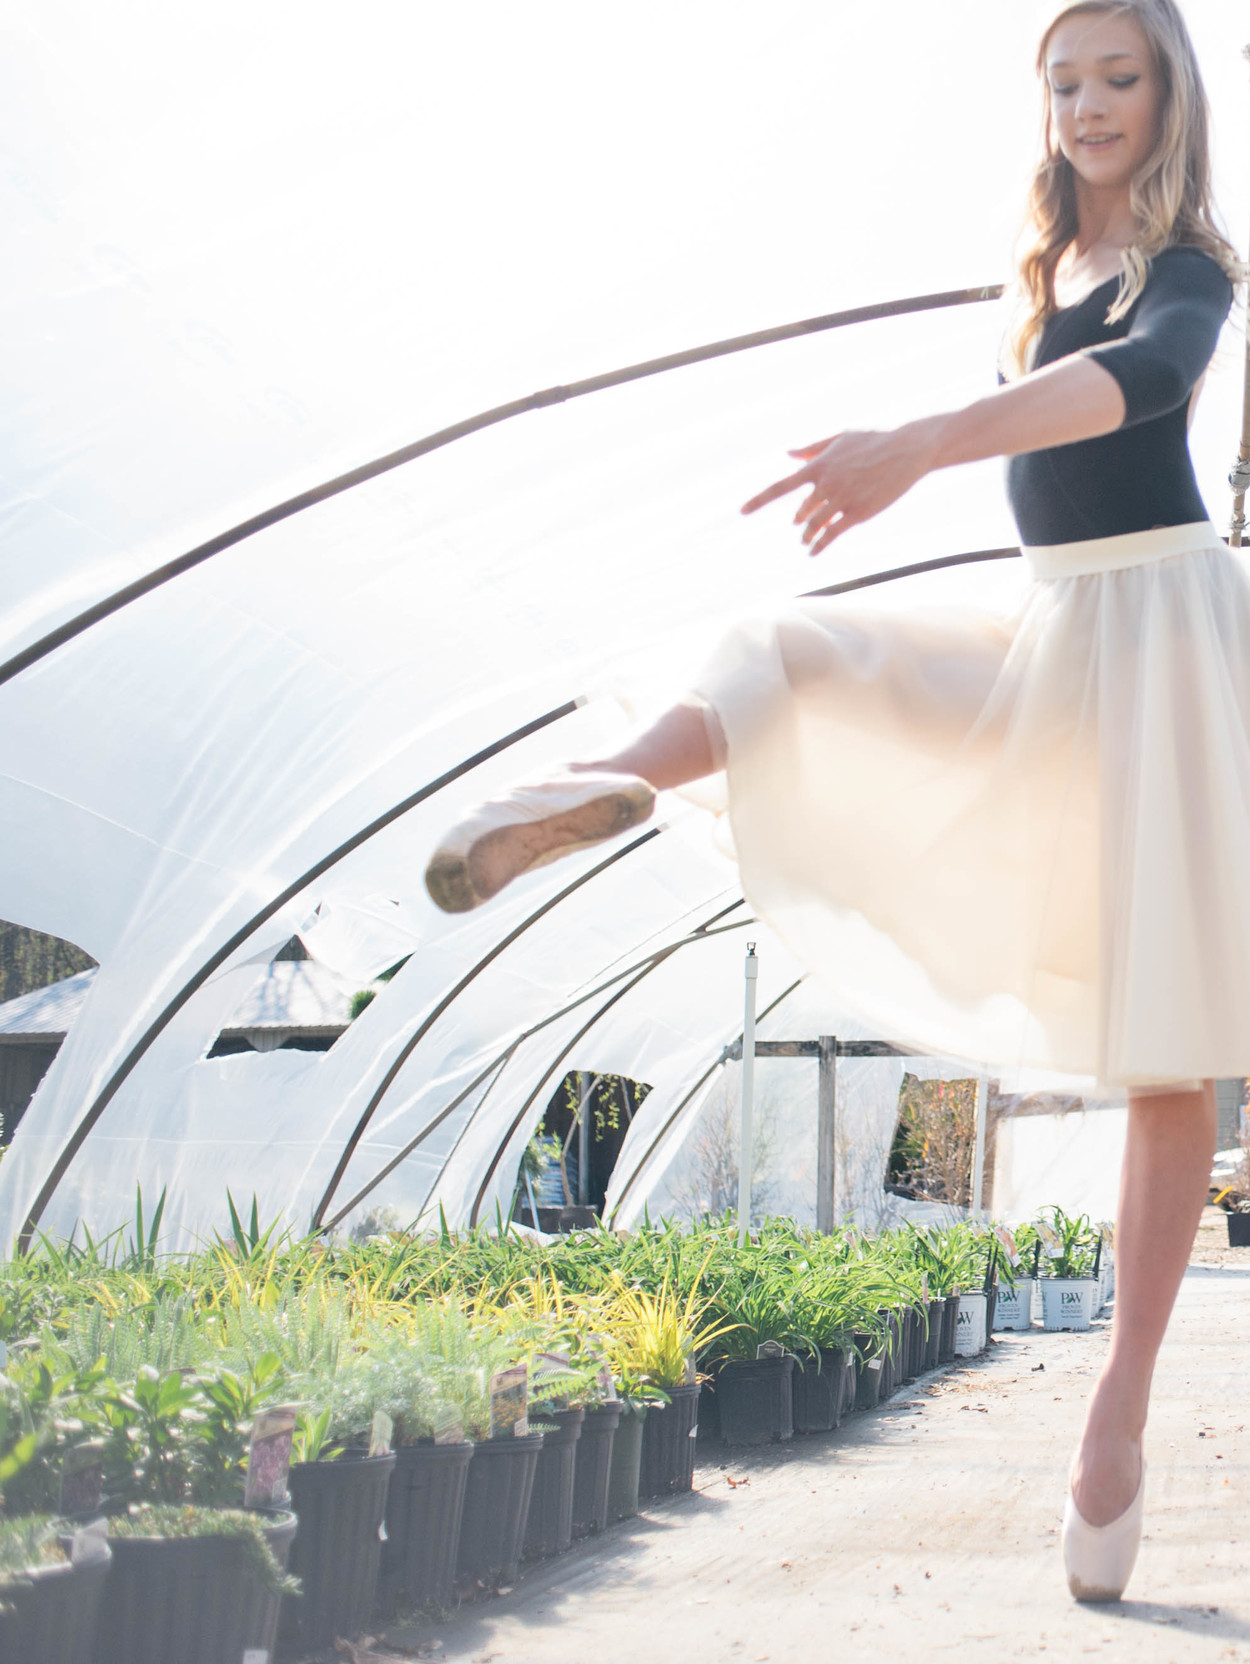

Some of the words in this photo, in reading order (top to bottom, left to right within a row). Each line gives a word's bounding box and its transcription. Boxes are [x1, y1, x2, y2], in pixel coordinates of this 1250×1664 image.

[998, 1291, 1020, 1304] PW
[1061, 1292, 1083, 1304] PW
[957, 1311, 974, 1325] W
